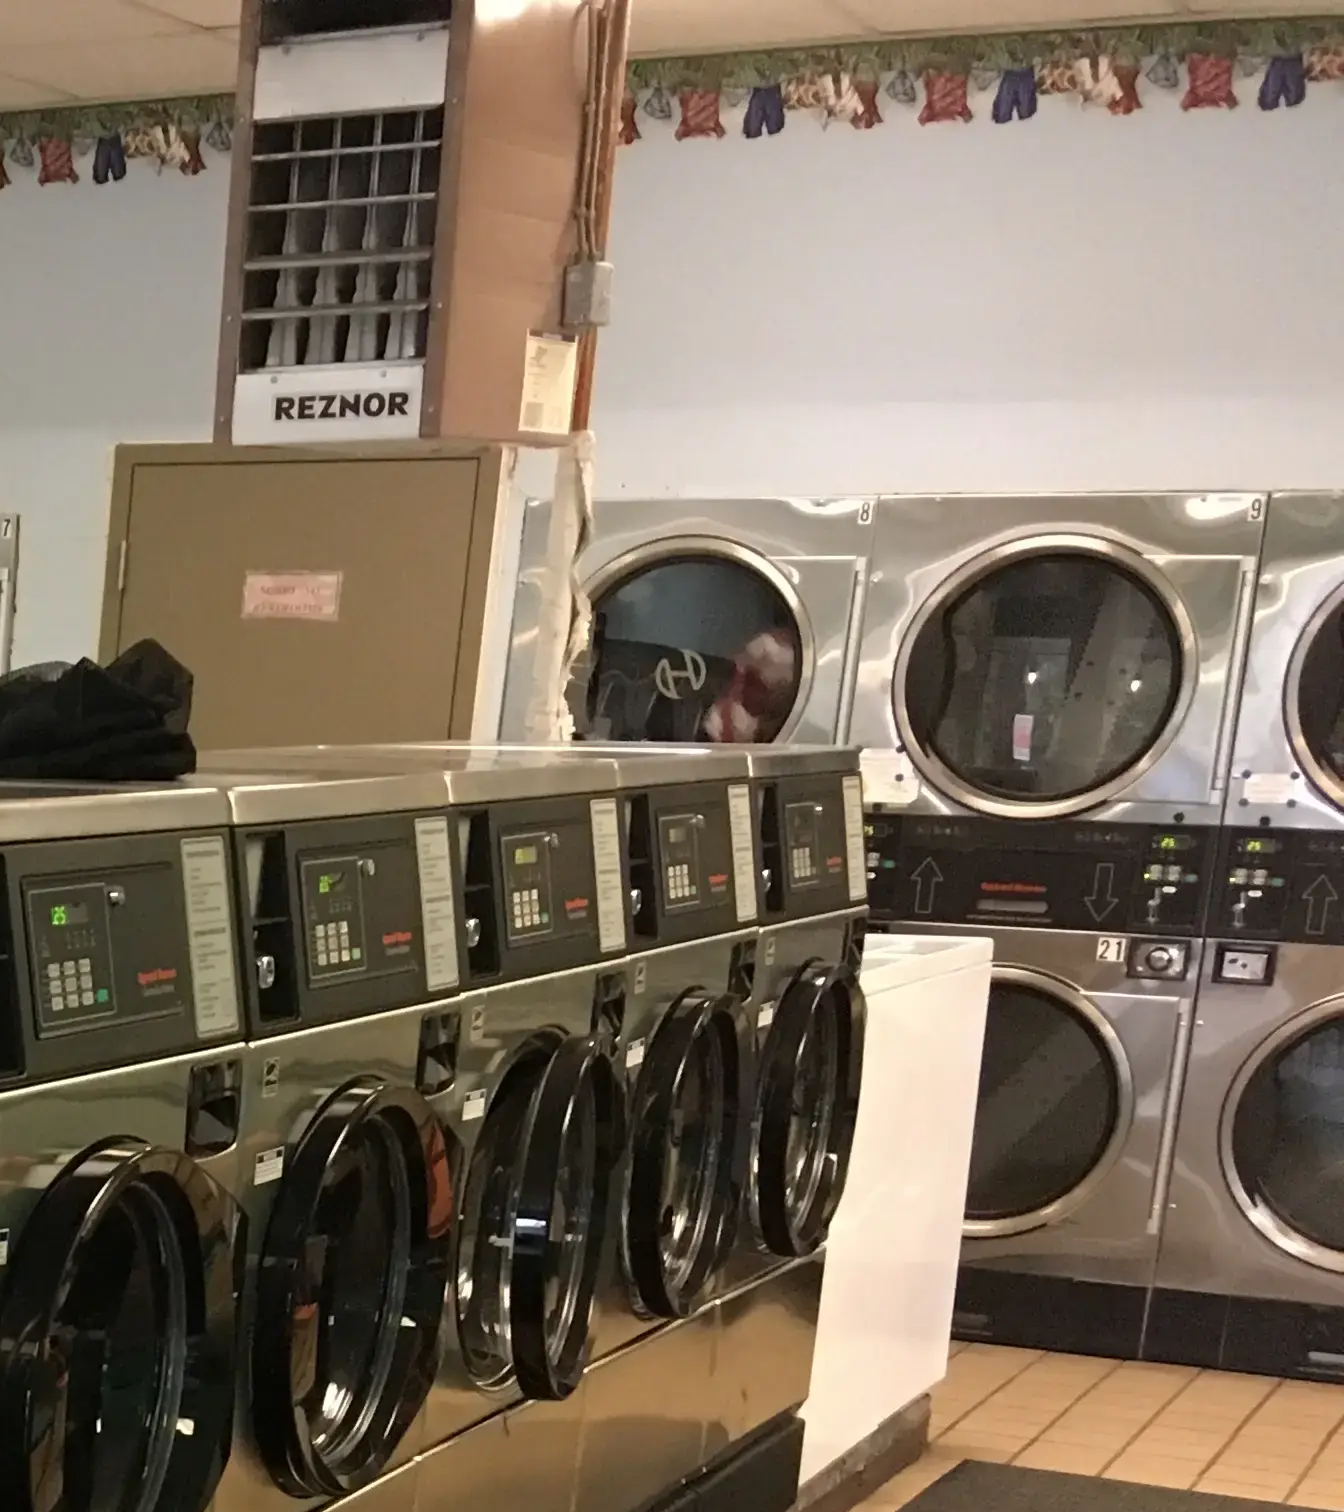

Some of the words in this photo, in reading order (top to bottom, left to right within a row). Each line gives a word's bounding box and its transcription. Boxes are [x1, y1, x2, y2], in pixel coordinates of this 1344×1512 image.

[274, 392, 409, 420] REZNOR
[860, 501, 871, 522] 8
[1251, 498, 1262, 520] 9
[3, 518, 11, 537] 7
[1098, 939, 1124, 961] 21
